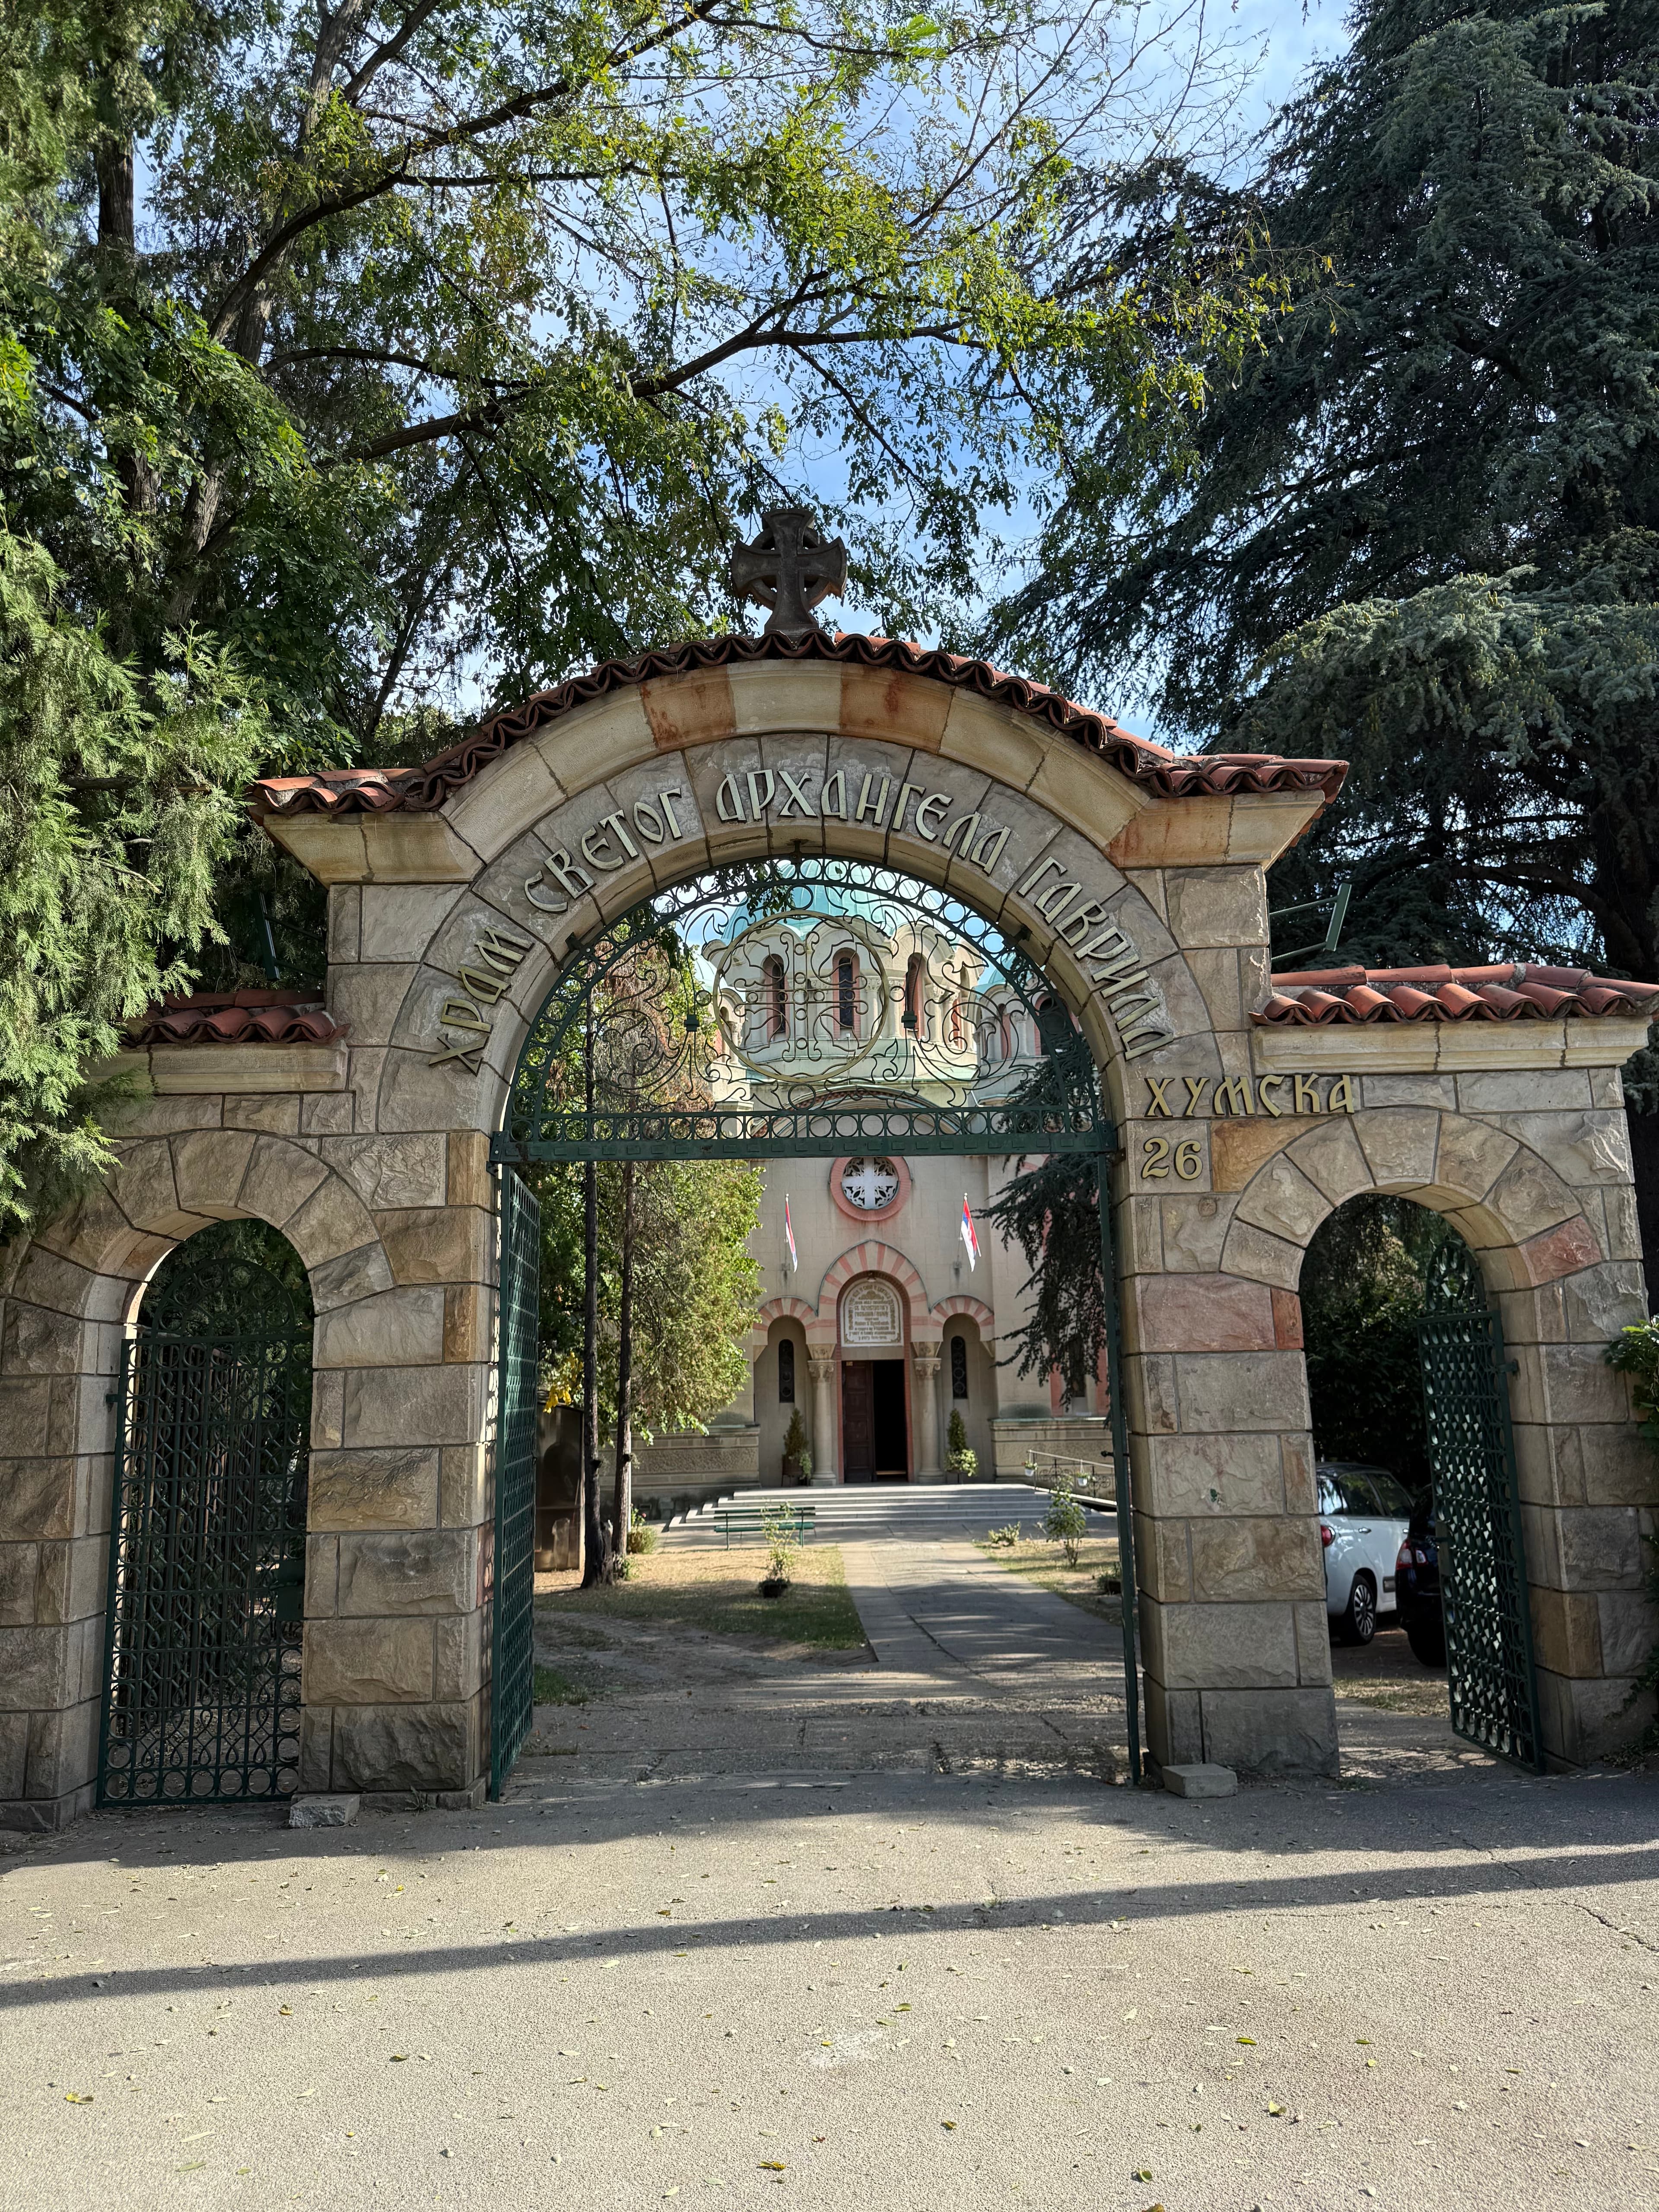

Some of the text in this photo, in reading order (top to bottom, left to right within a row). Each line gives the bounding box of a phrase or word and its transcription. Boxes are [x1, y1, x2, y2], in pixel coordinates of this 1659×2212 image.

[429, 769, 1173, 1077] ХРАМ СВЕТОГ АРХАНГЕЛА ГАВРИЛА
[1144, 1072, 1354, 1117] ХУМСКА
[1142, 1137, 1203, 1180] 26
